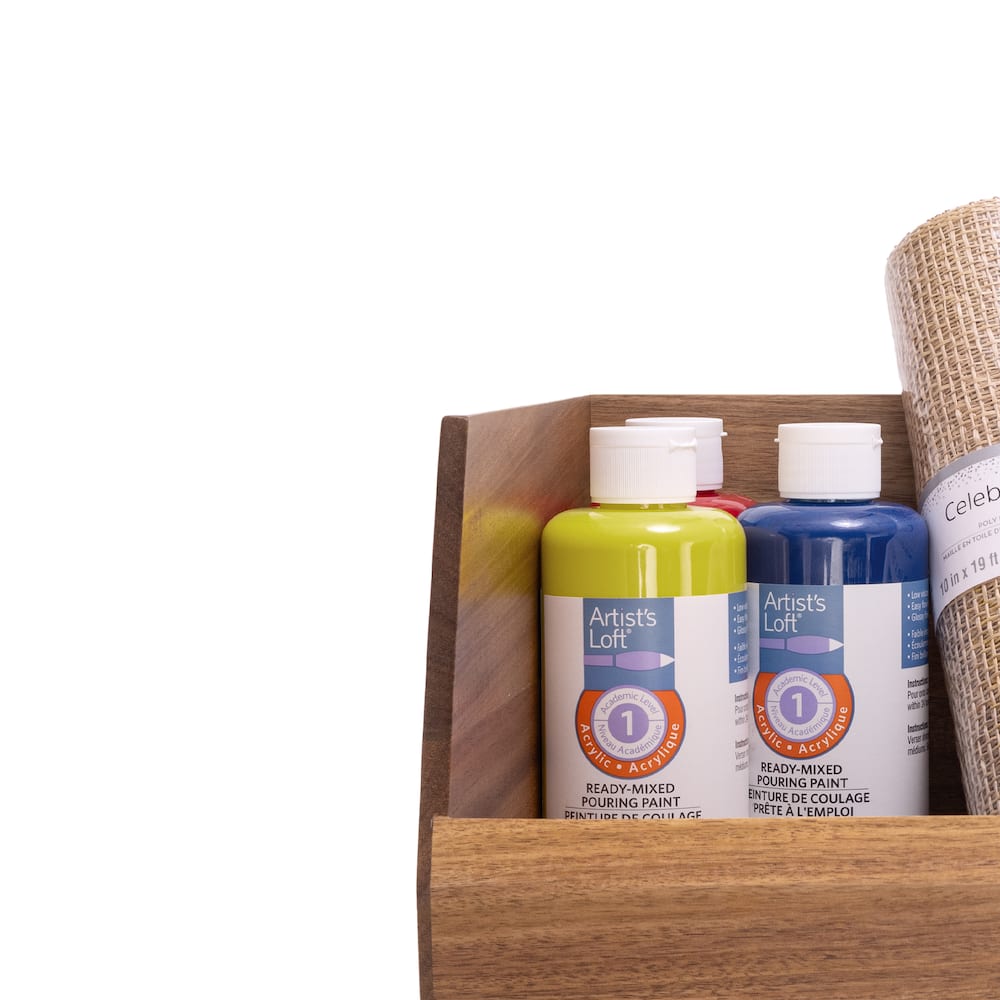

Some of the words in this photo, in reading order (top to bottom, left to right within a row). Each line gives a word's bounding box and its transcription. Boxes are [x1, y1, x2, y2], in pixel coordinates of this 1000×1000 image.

[978, 517, 997, 528] POLY
[972, 530, 992, 543] TOILE
[940, 578, 949, 596] 10
[950, 572, 960, 587] in
[962, 567, 969, 580] x
[970, 556, 986, 574] 19
[989, 551, 999, 567] ft
[764, 591, 826, 612] Artist's
[589, 606, 657, 627] Artist's
[773, 675, 808, 696] Academic
[809, 677, 828, 697] Level
[600, 693, 639, 714] Academic
[639, 695, 660, 714] Level
[791, 692, 803, 718] 1
[621, 710, 633, 736] 1
[756, 704, 783, 748] Acrylic
[798, 706, 848, 754] Acrylique
[770, 705, 787, 731] Niveau
[788, 707, 831, 736] Académique
[580, 723, 612, 768] Acrylic
[628, 723, 680, 773] Acrylique
[598, 723, 617, 750] Niveau
[617, 724, 662, 755] Académique
[761, 762, 843, 775] READY-MIXED
[586, 783, 675, 794] READY-MIXED
[757, 775, 807, 788] POURING
[810, 778, 848, 788] PAINT
[581, 796, 638, 808] POURING
[642, 796, 681, 808] PAINT
[748, 789, 788, 803] EINTURE
[791, 793, 807, 803] DE
[810, 793, 870, 804] COULAGE
[753, 802, 783, 816] PRÊTE
[785, 804, 794, 816] À
[797, 806, 854, 817] L'EMPLOI
